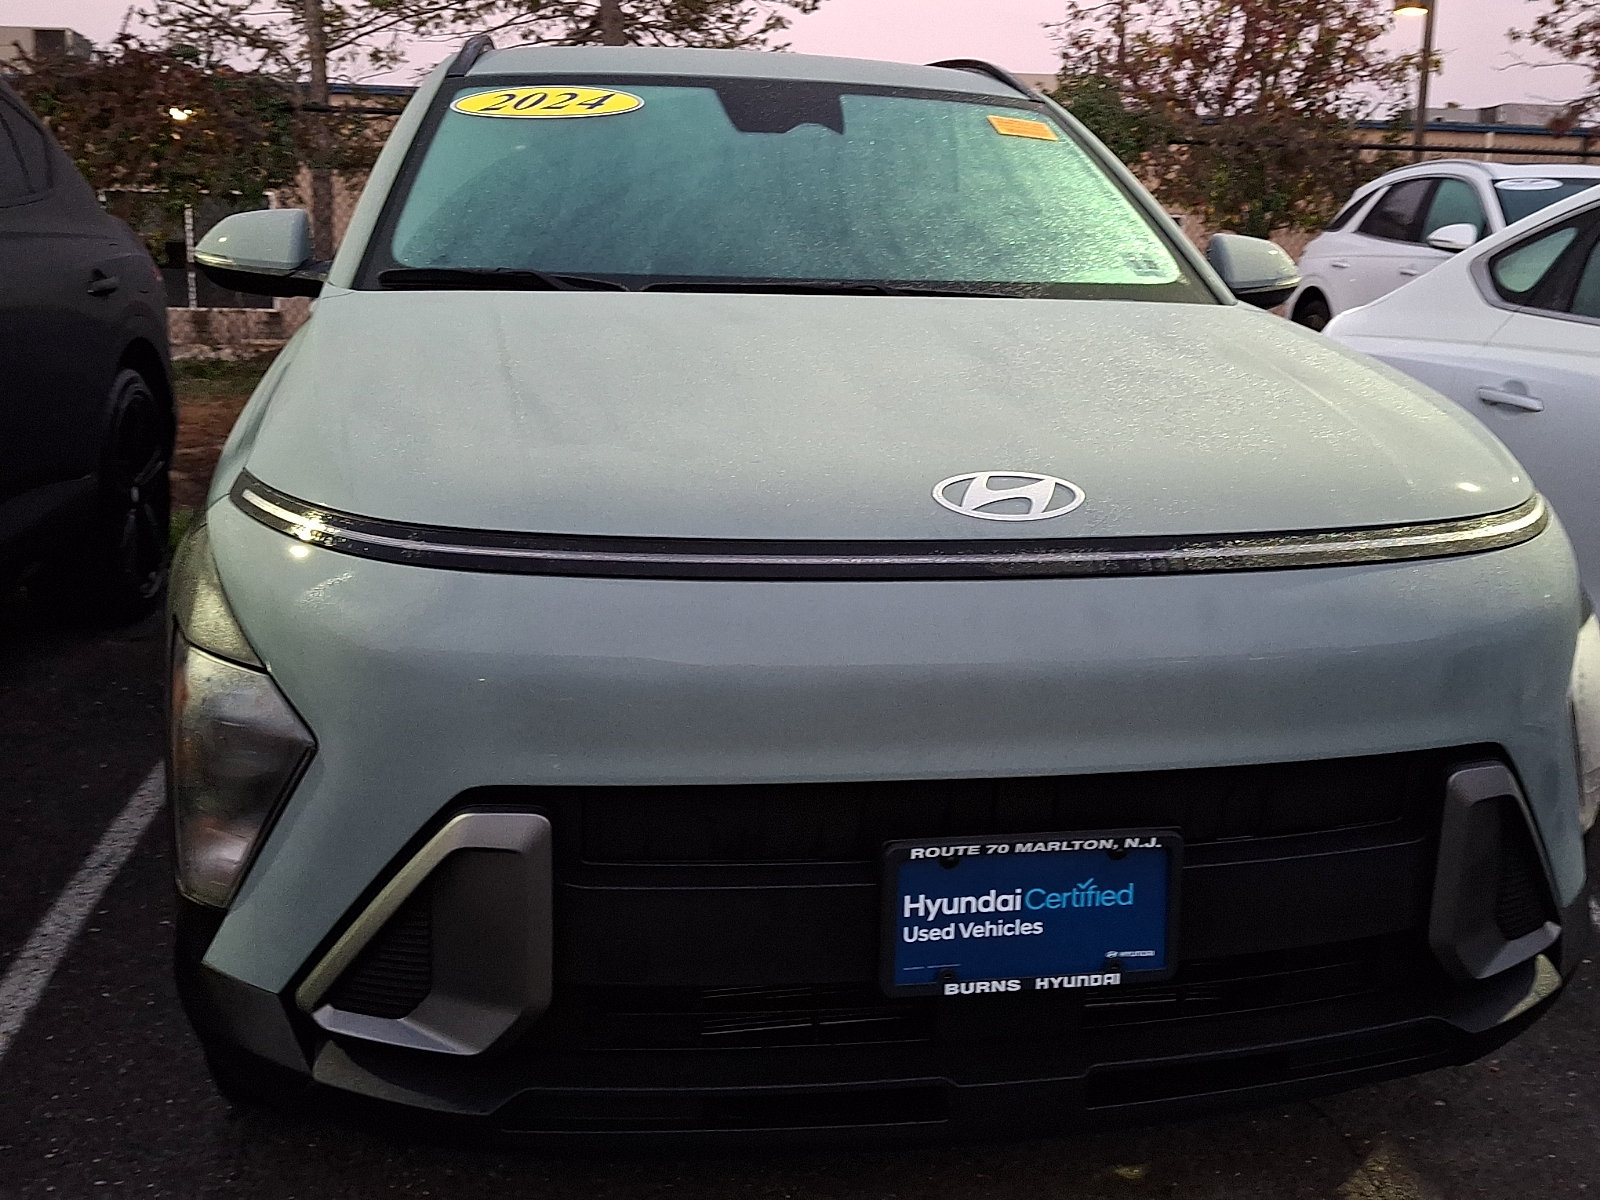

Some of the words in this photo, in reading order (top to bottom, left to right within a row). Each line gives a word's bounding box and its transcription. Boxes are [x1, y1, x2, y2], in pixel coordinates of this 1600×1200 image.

[477, 92, 616, 111] 2024
[909, 844, 981, 859] ROUTE
[986, 843, 1010, 855] 70
[1014, 839, 1119, 853] MARLTON,
[1123, 837, 1163, 849] N.J.
[903, 888, 1022, 921] Hyundai
[1025, 881, 1135, 910] Certified
[903, 922, 956, 943] Used
[959, 919, 1044, 939] Vehicles
[944, 980, 1022, 996] BURNS
[1035, 973, 1121, 990] HYUNDAI
